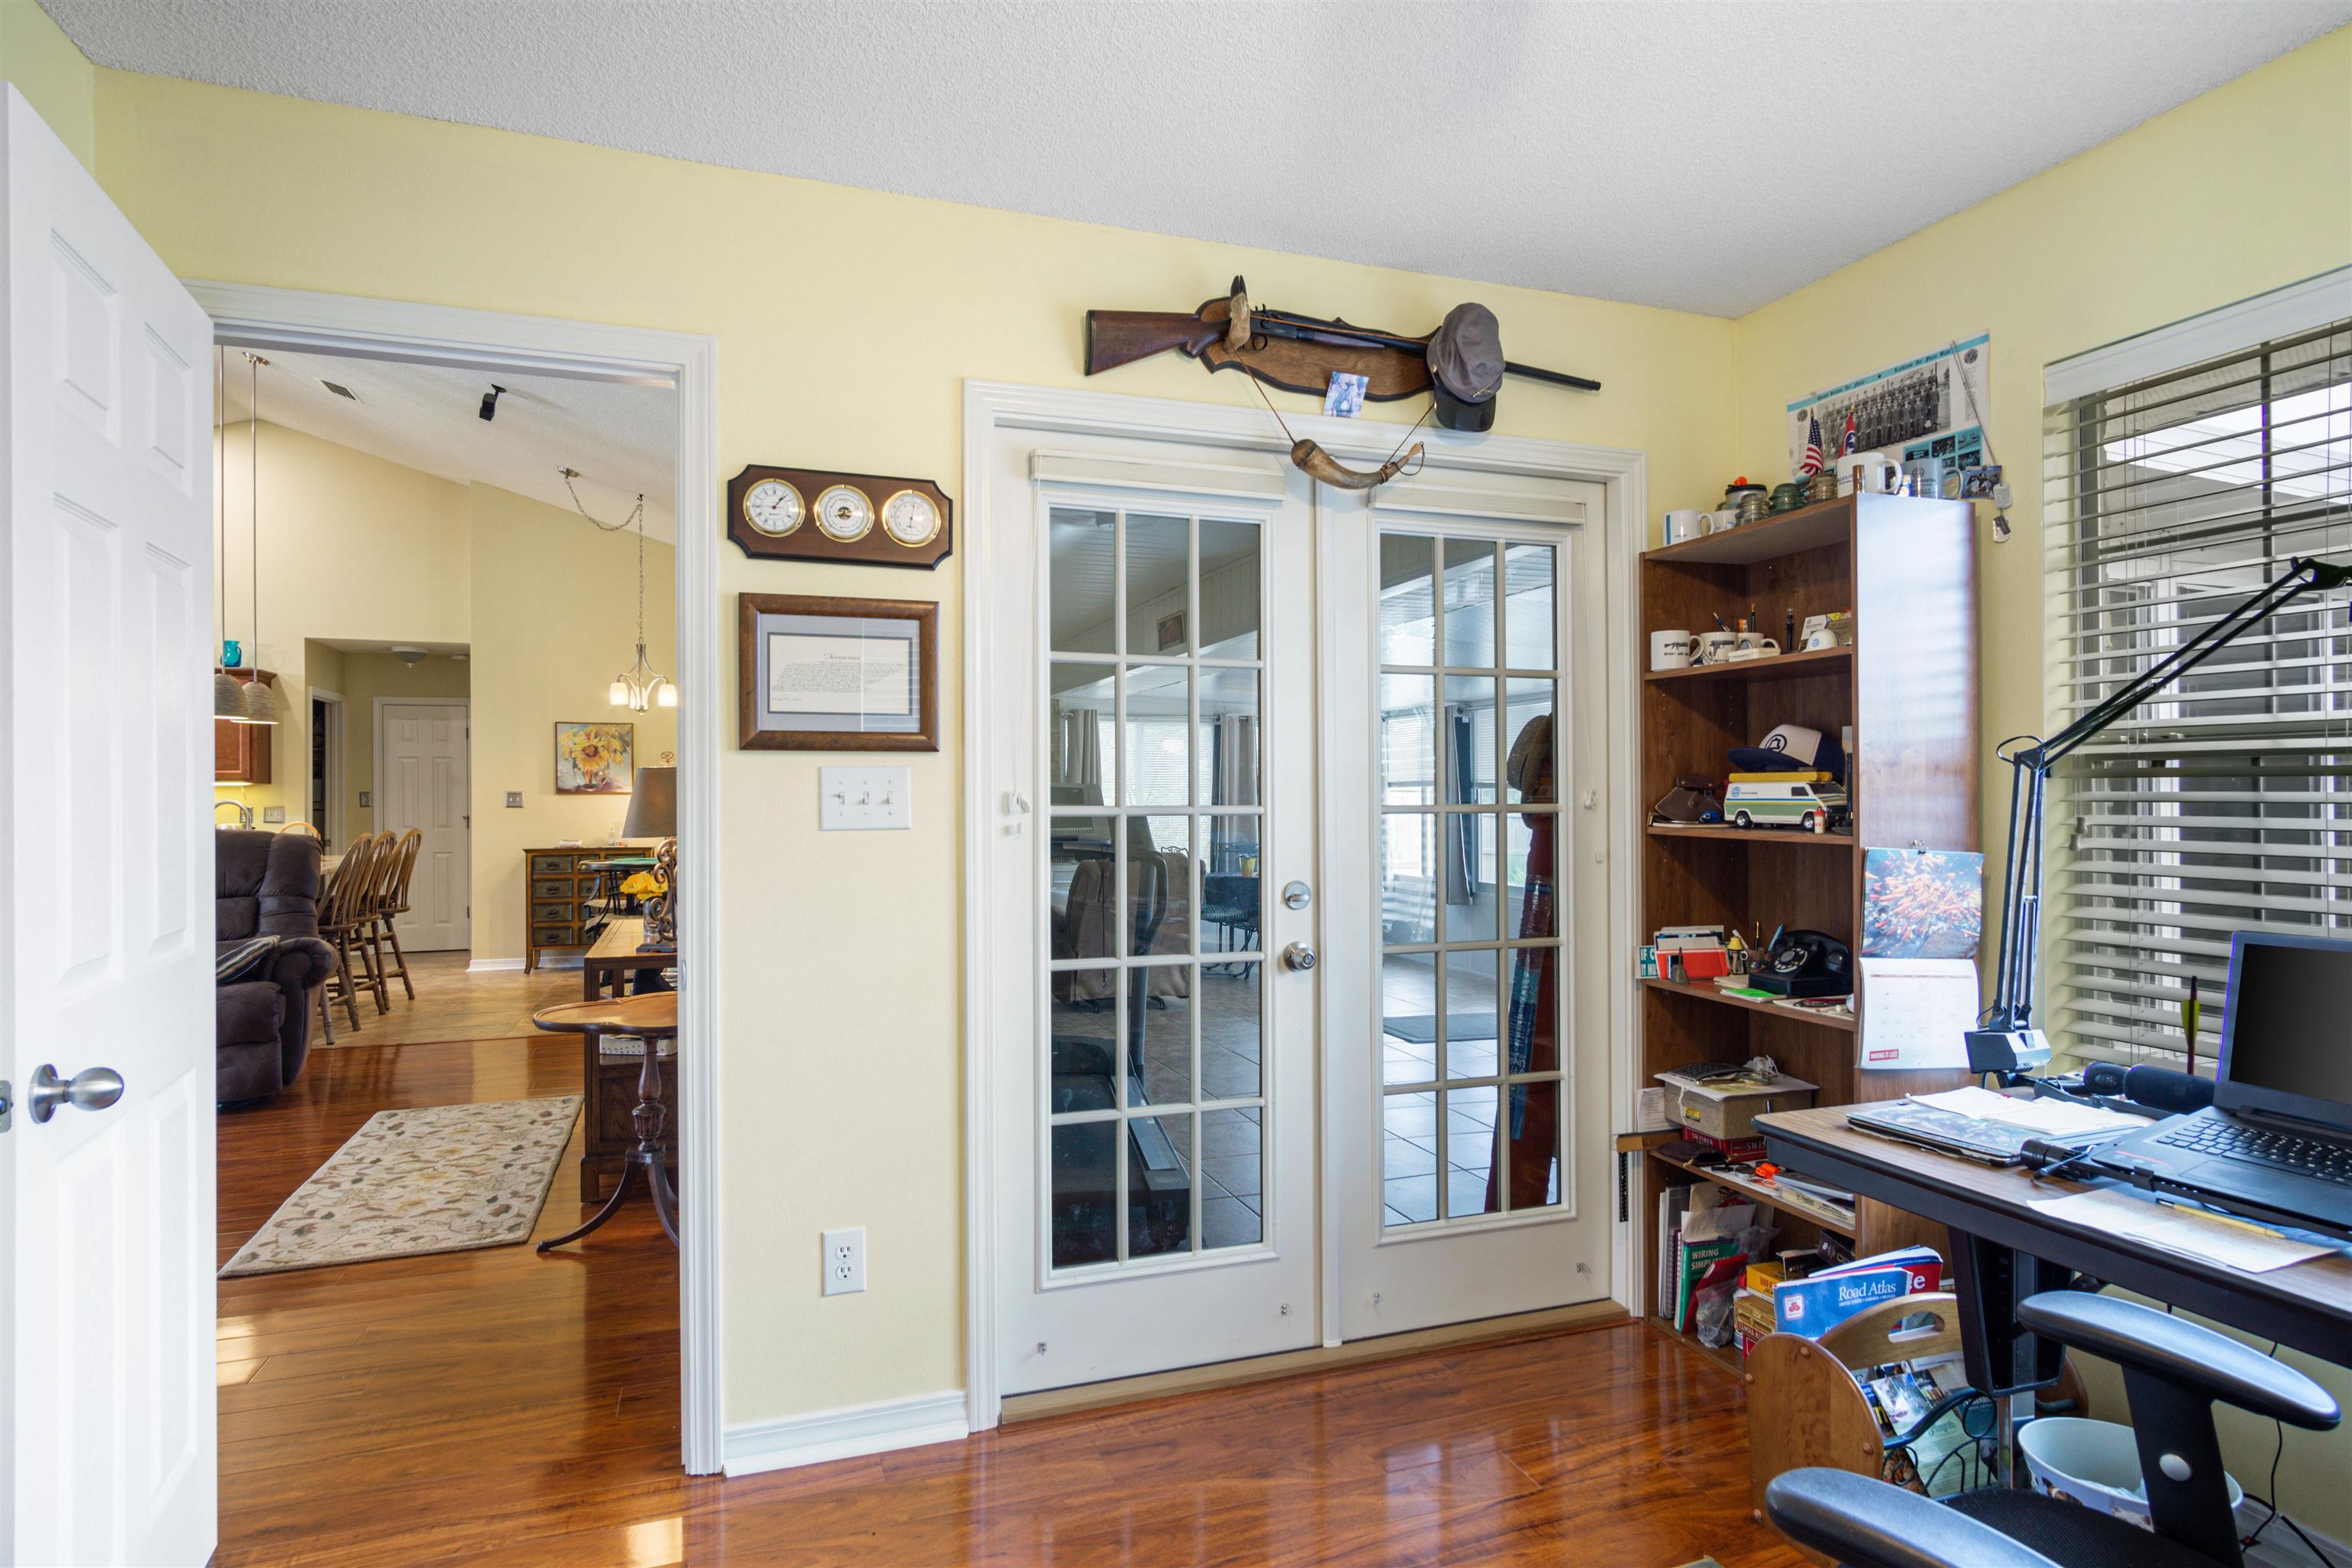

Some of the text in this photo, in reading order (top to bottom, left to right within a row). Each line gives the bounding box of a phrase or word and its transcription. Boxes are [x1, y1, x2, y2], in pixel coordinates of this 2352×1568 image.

[1641, 948, 1647, 961] IF
[1641, 963, 1646, 976] IT
[1746, 1140, 1766, 1151] SWIS
[1692, 1249, 1719, 1259] WIRING
[1838, 1280, 1896, 1302] Road Atlas
